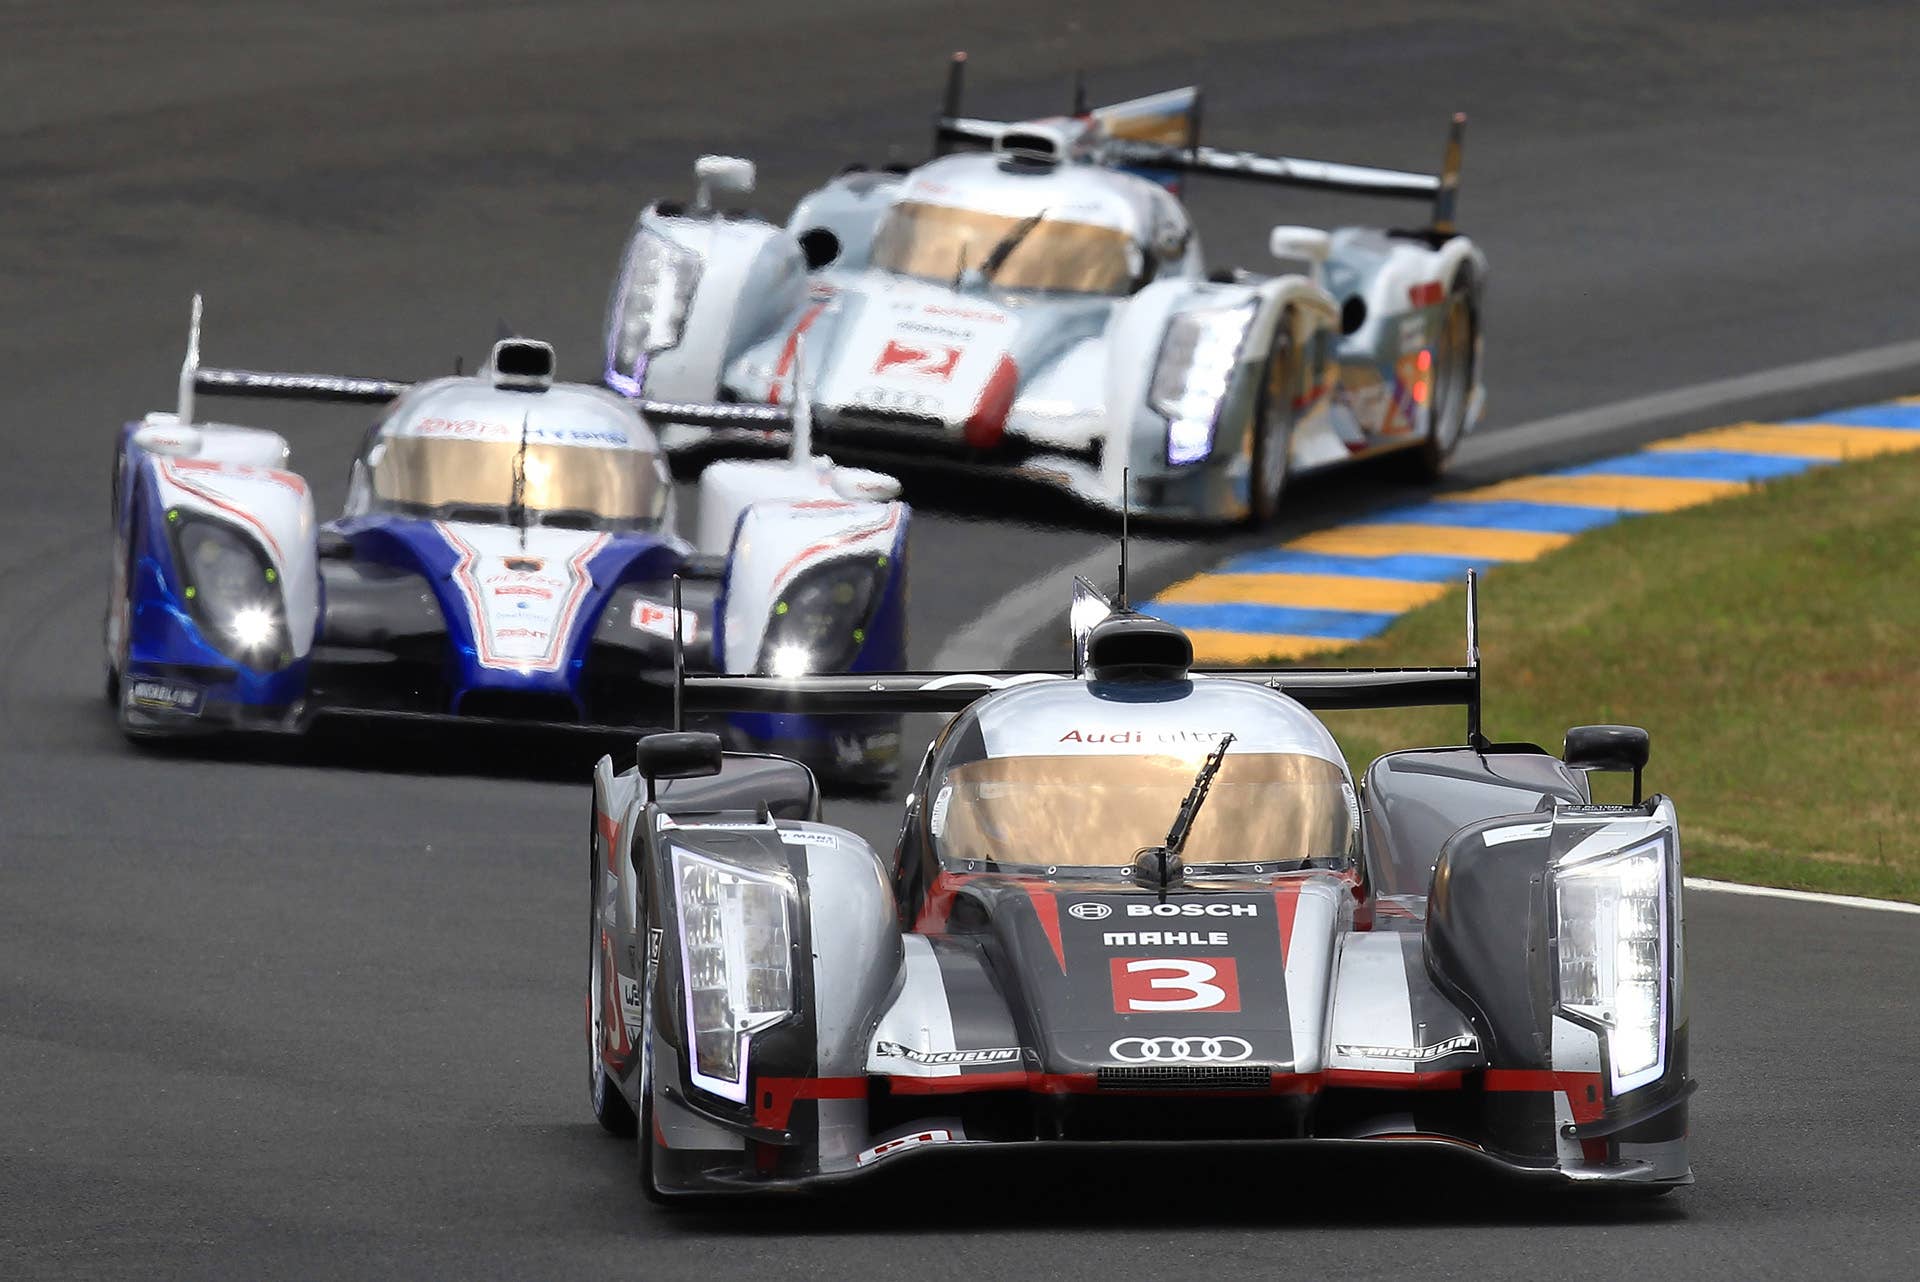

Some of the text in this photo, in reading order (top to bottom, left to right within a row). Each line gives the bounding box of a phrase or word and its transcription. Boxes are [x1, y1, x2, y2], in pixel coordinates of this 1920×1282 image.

[1059, 730, 1142, 743] Audi
[1126, 904, 1258, 916] BOSCH
[1103, 931, 1229, 945] MAHLE
[1126, 959, 1226, 1011] 3
[1366, 1037, 1473, 1058] MICHELIN
[906, 1049, 1014, 1063] MICHELIN
